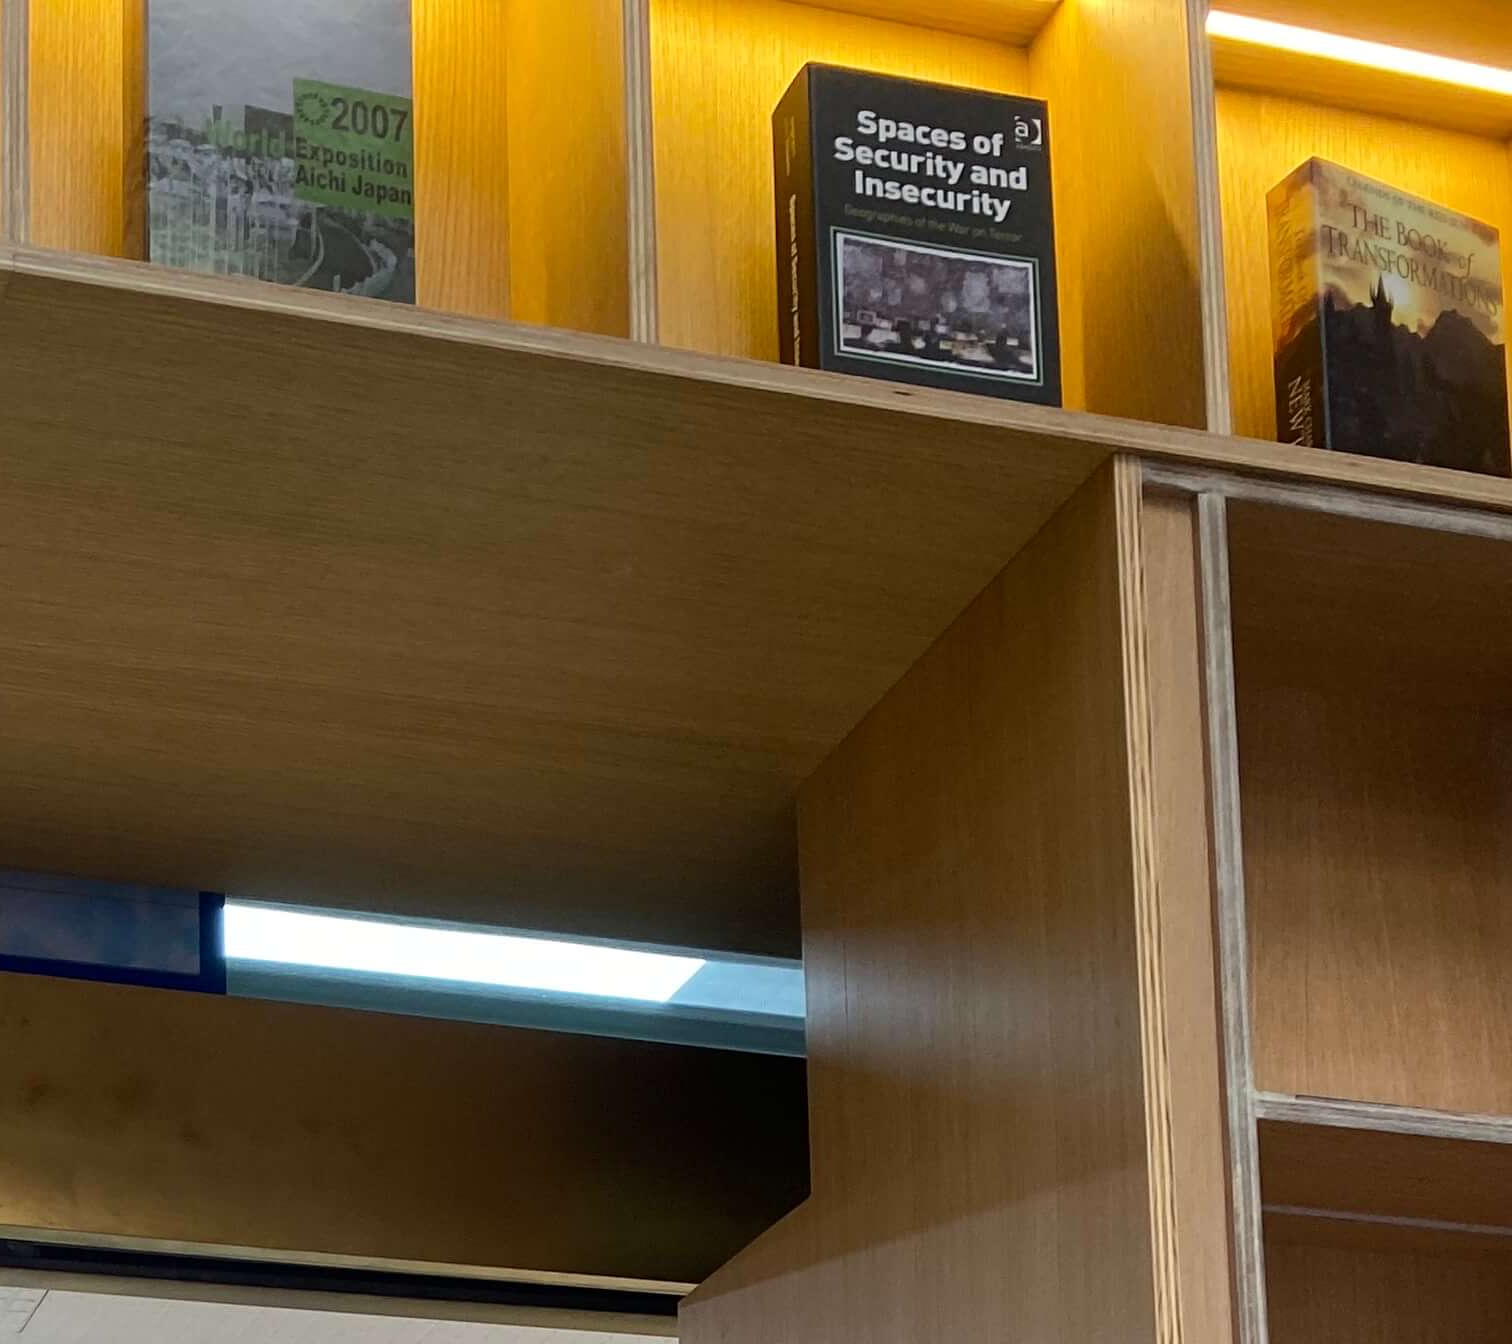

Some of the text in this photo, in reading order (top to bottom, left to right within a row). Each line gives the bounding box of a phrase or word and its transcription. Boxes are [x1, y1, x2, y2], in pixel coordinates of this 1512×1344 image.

[331, 97, 408, 142] 2007
[857, 109, 1005, 156] Spaces of
[295, 137, 408, 178] Exposition
[834, 136, 965, 185] Security
[969, 164, 1028, 190] and
[295, 165, 412, 206] Aichi Japan
[855, 170, 1011, 222] Insecurity
[1350, 204, 1475, 278] THE BOOK of
[1321, 224, 1498, 316] TRANSFORMATIONS
